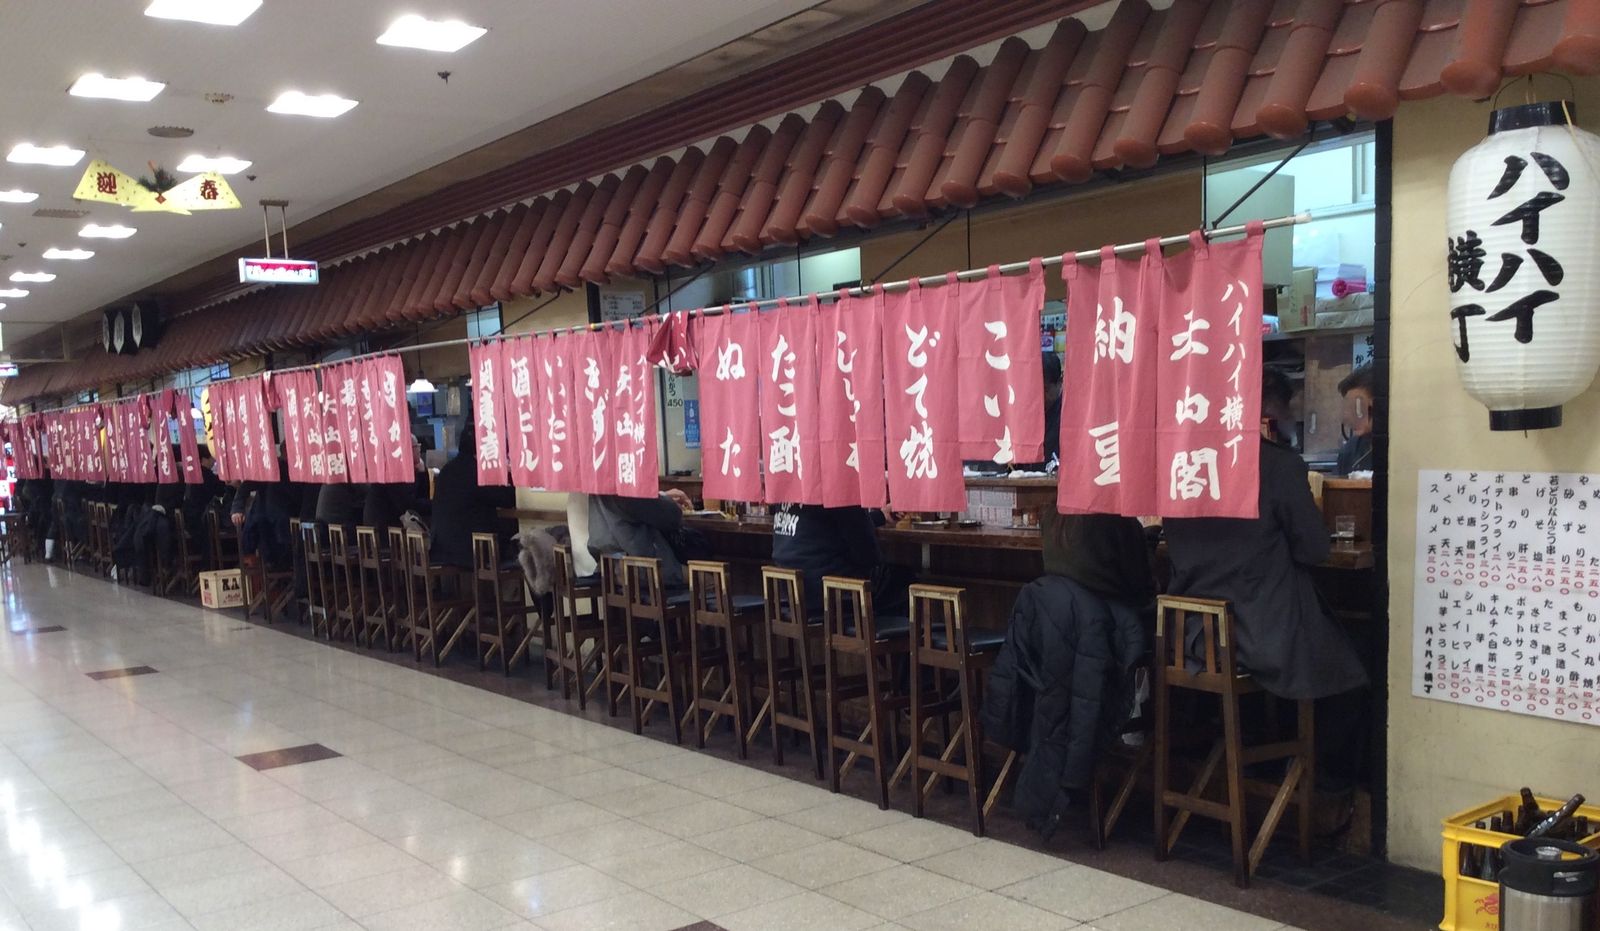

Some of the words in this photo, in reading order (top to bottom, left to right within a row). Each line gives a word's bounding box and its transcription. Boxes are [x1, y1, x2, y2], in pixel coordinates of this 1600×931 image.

[97, 172, 117, 195] 迎
[200, 179, 219, 200] 春
[1486, 151, 1570, 344] ハイハイ
[1447, 229, 1486, 363] 横丁
[667, 399, 684, 407] 450
[716, 337, 746, 477] ぬた
[899, 322, 941, 479] どて焼
[1088, 296, 1137, 486] 納豆
[1219, 280, 1249, 469] ハイハイ横丁
